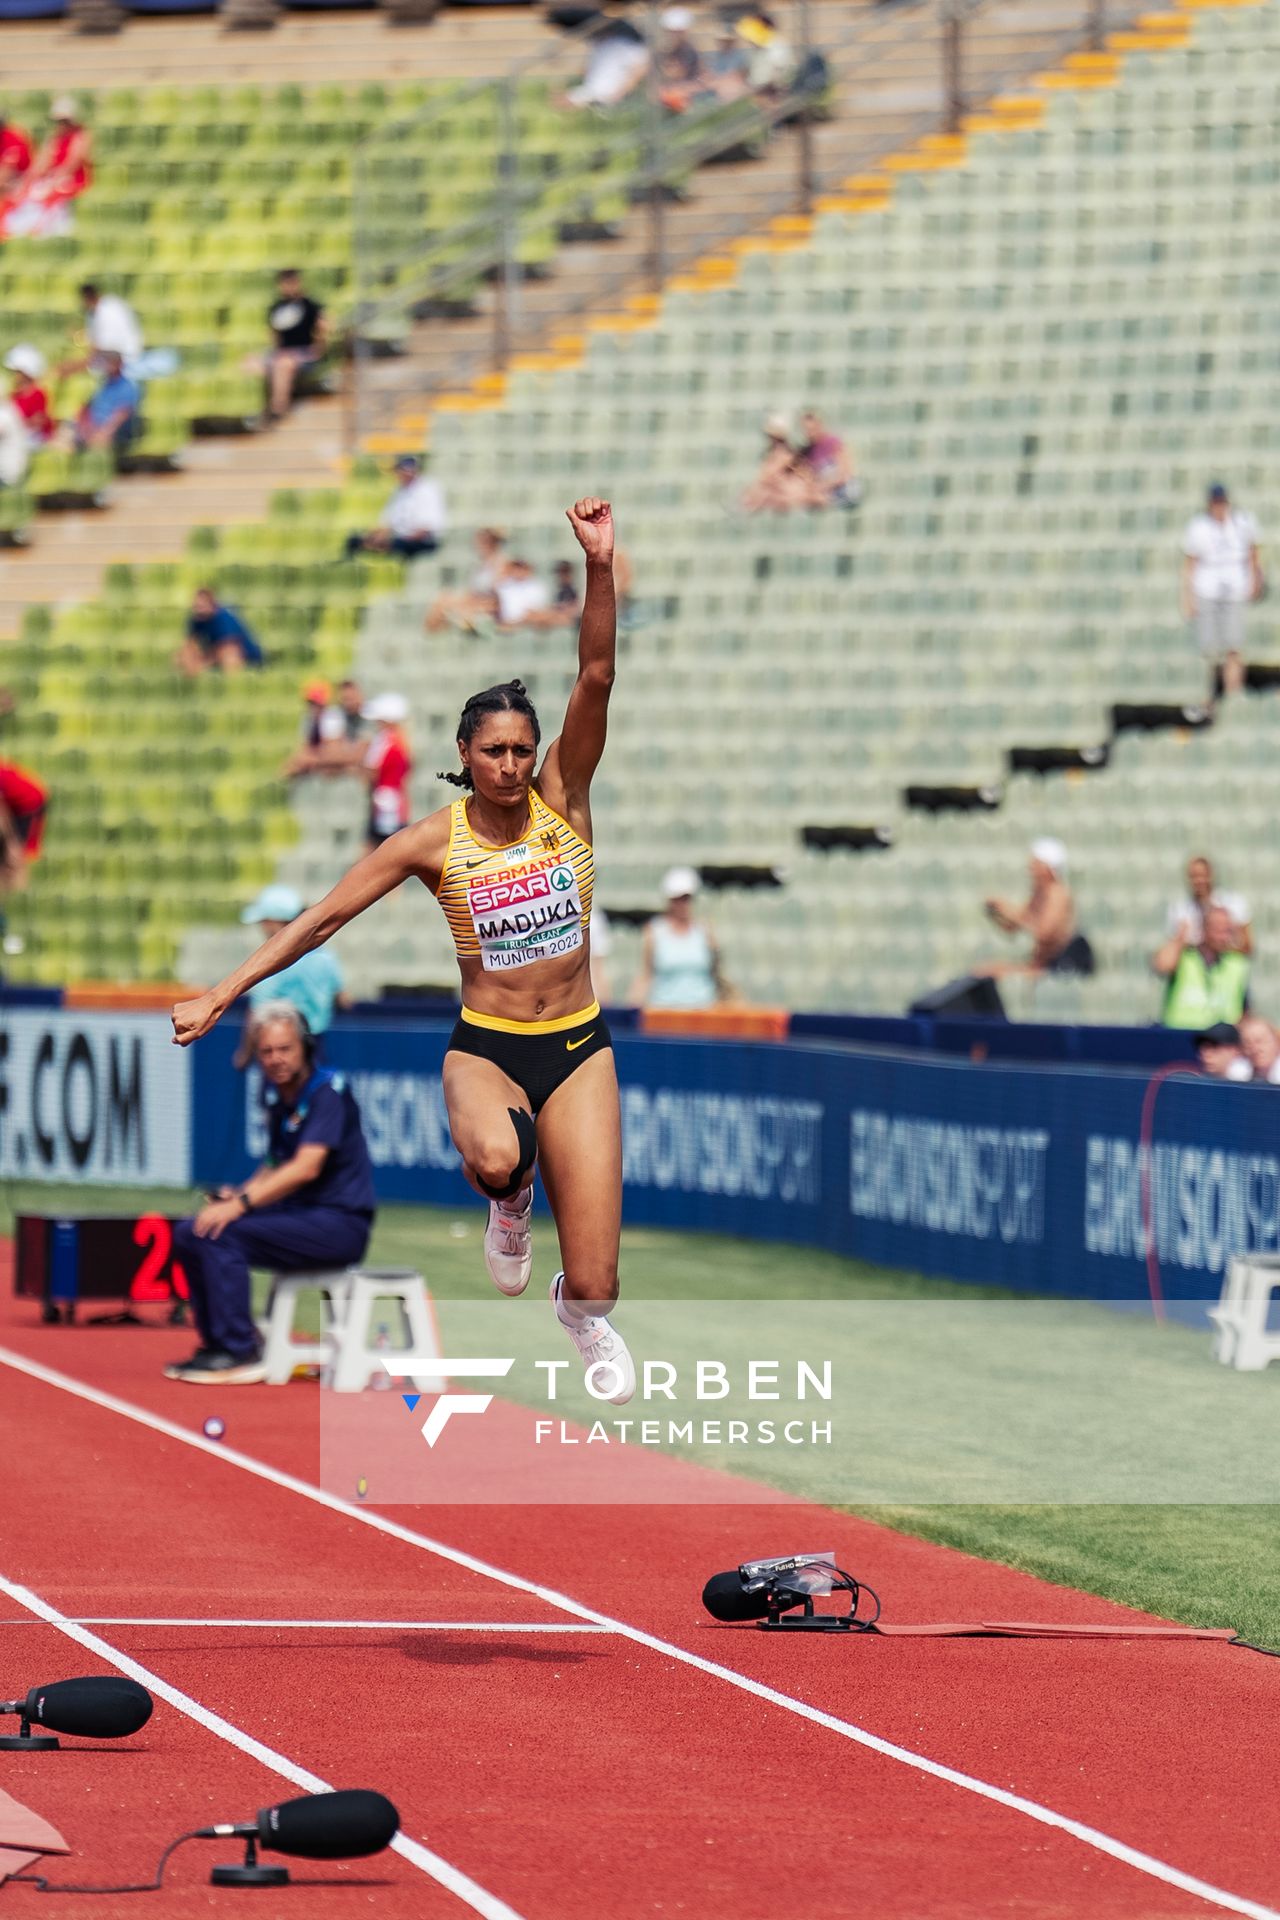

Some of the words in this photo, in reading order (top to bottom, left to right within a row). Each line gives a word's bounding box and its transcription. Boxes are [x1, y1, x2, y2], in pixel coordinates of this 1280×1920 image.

[470, 854, 562, 888] GERMANY
[471, 877, 548, 911] SPAR
[478, 898, 579, 939] MADUKA
[489, 945, 546, 967] MUNICH
[549, 932, 579, 955] 2022
[509, 938, 530, 949] RUN
[531, 929, 560, 945] CLEAN
